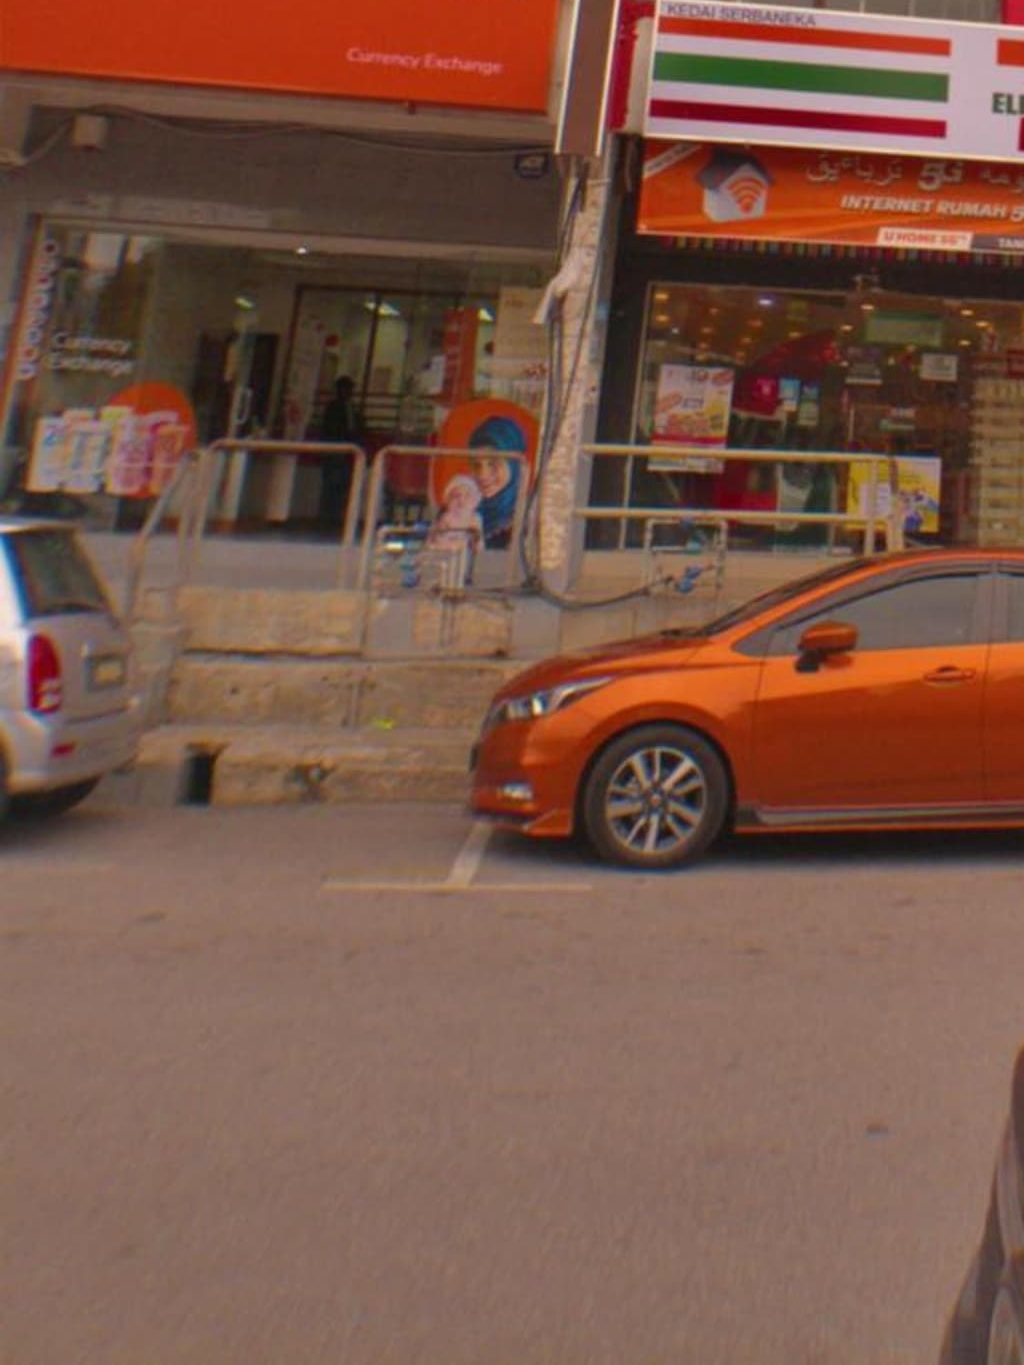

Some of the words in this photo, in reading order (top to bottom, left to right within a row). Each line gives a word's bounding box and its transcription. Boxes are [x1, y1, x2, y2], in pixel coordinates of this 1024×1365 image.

[667, 2, 716, 19] KEDAI
[719, 7, 817, 27] SERBANEKA
[346, 46, 421, 70] Currency
[423, 51, 505, 76] Exchange
[840, 194, 934, 215] INTERNET
[935, 199, 1007, 219] RUMAH
